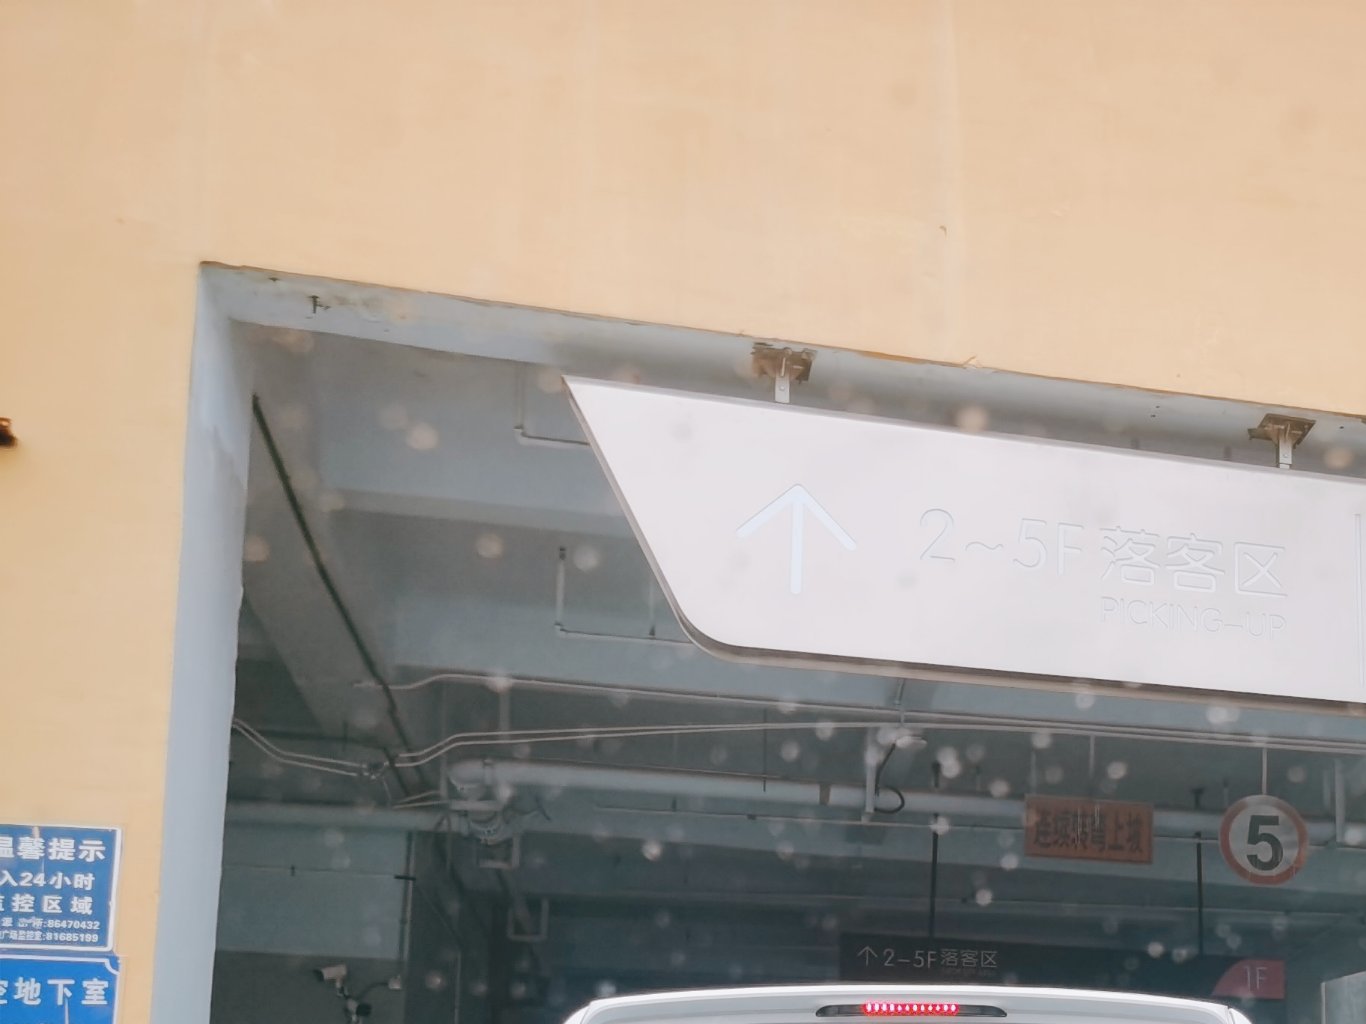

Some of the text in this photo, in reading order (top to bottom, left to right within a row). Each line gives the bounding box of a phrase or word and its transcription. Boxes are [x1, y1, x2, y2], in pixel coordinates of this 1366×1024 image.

[1102, 597, 1287, 640] PICKING-UP
[1246, 814, 1284, 871] 5
[0, 894, 93, 915] 控区域
